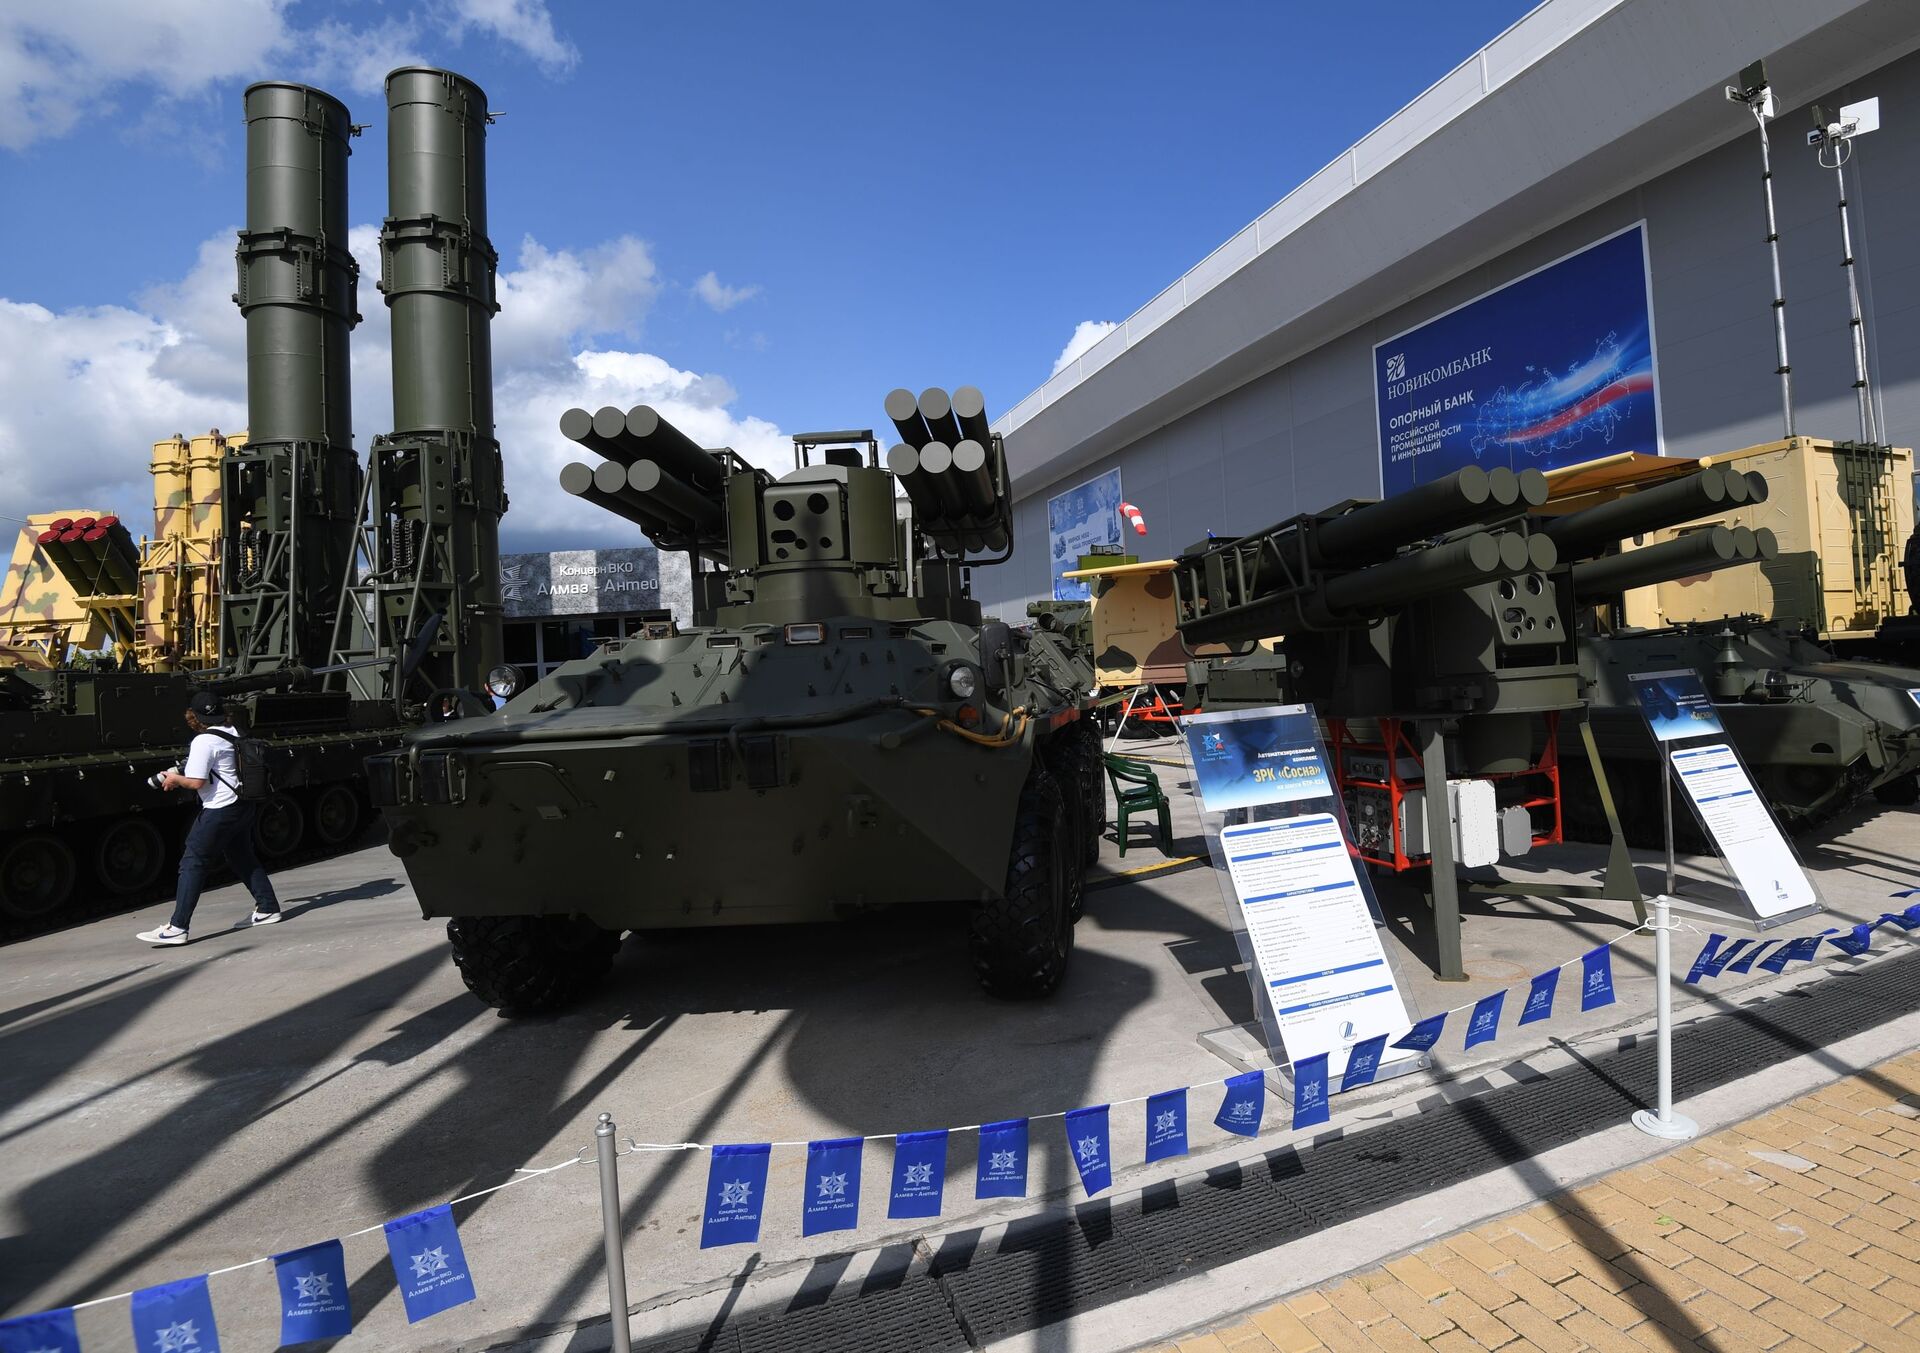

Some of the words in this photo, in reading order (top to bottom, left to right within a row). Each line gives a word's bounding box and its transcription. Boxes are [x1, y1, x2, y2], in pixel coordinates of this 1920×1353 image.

[1387, 346, 1492, 400] НОВИКОМБАНК
[1389, 400, 1442, 429] ОПОРНЫЙ
[1444, 389, 1475, 411] БАНК
[1390, 419, 1440, 444] РОССИЙСКОЙ
[1391, 424, 1462, 453] ПРОМЫШЛЕННОСТИ
[1391, 454, 1397, 463] И
[1397, 440, 1442, 461] ИННОВАЦИЙ
[559, 565, 607, 577] Концерн
[608, 562, 634, 573] ВКО
[537, 582, 589, 596] Алмаз
[604, 578, 660, 592] Антей
[1252, 767, 1277, 783] ЗРК
[1278, 765, 1321, 779] «Сосна»
[408, 1285, 434, 1298] Алмаз
[439, 1273, 465, 1286] Антей
[287, 1308, 313, 1317] Алмаз
[319, 1304, 345, 1313] Антей
